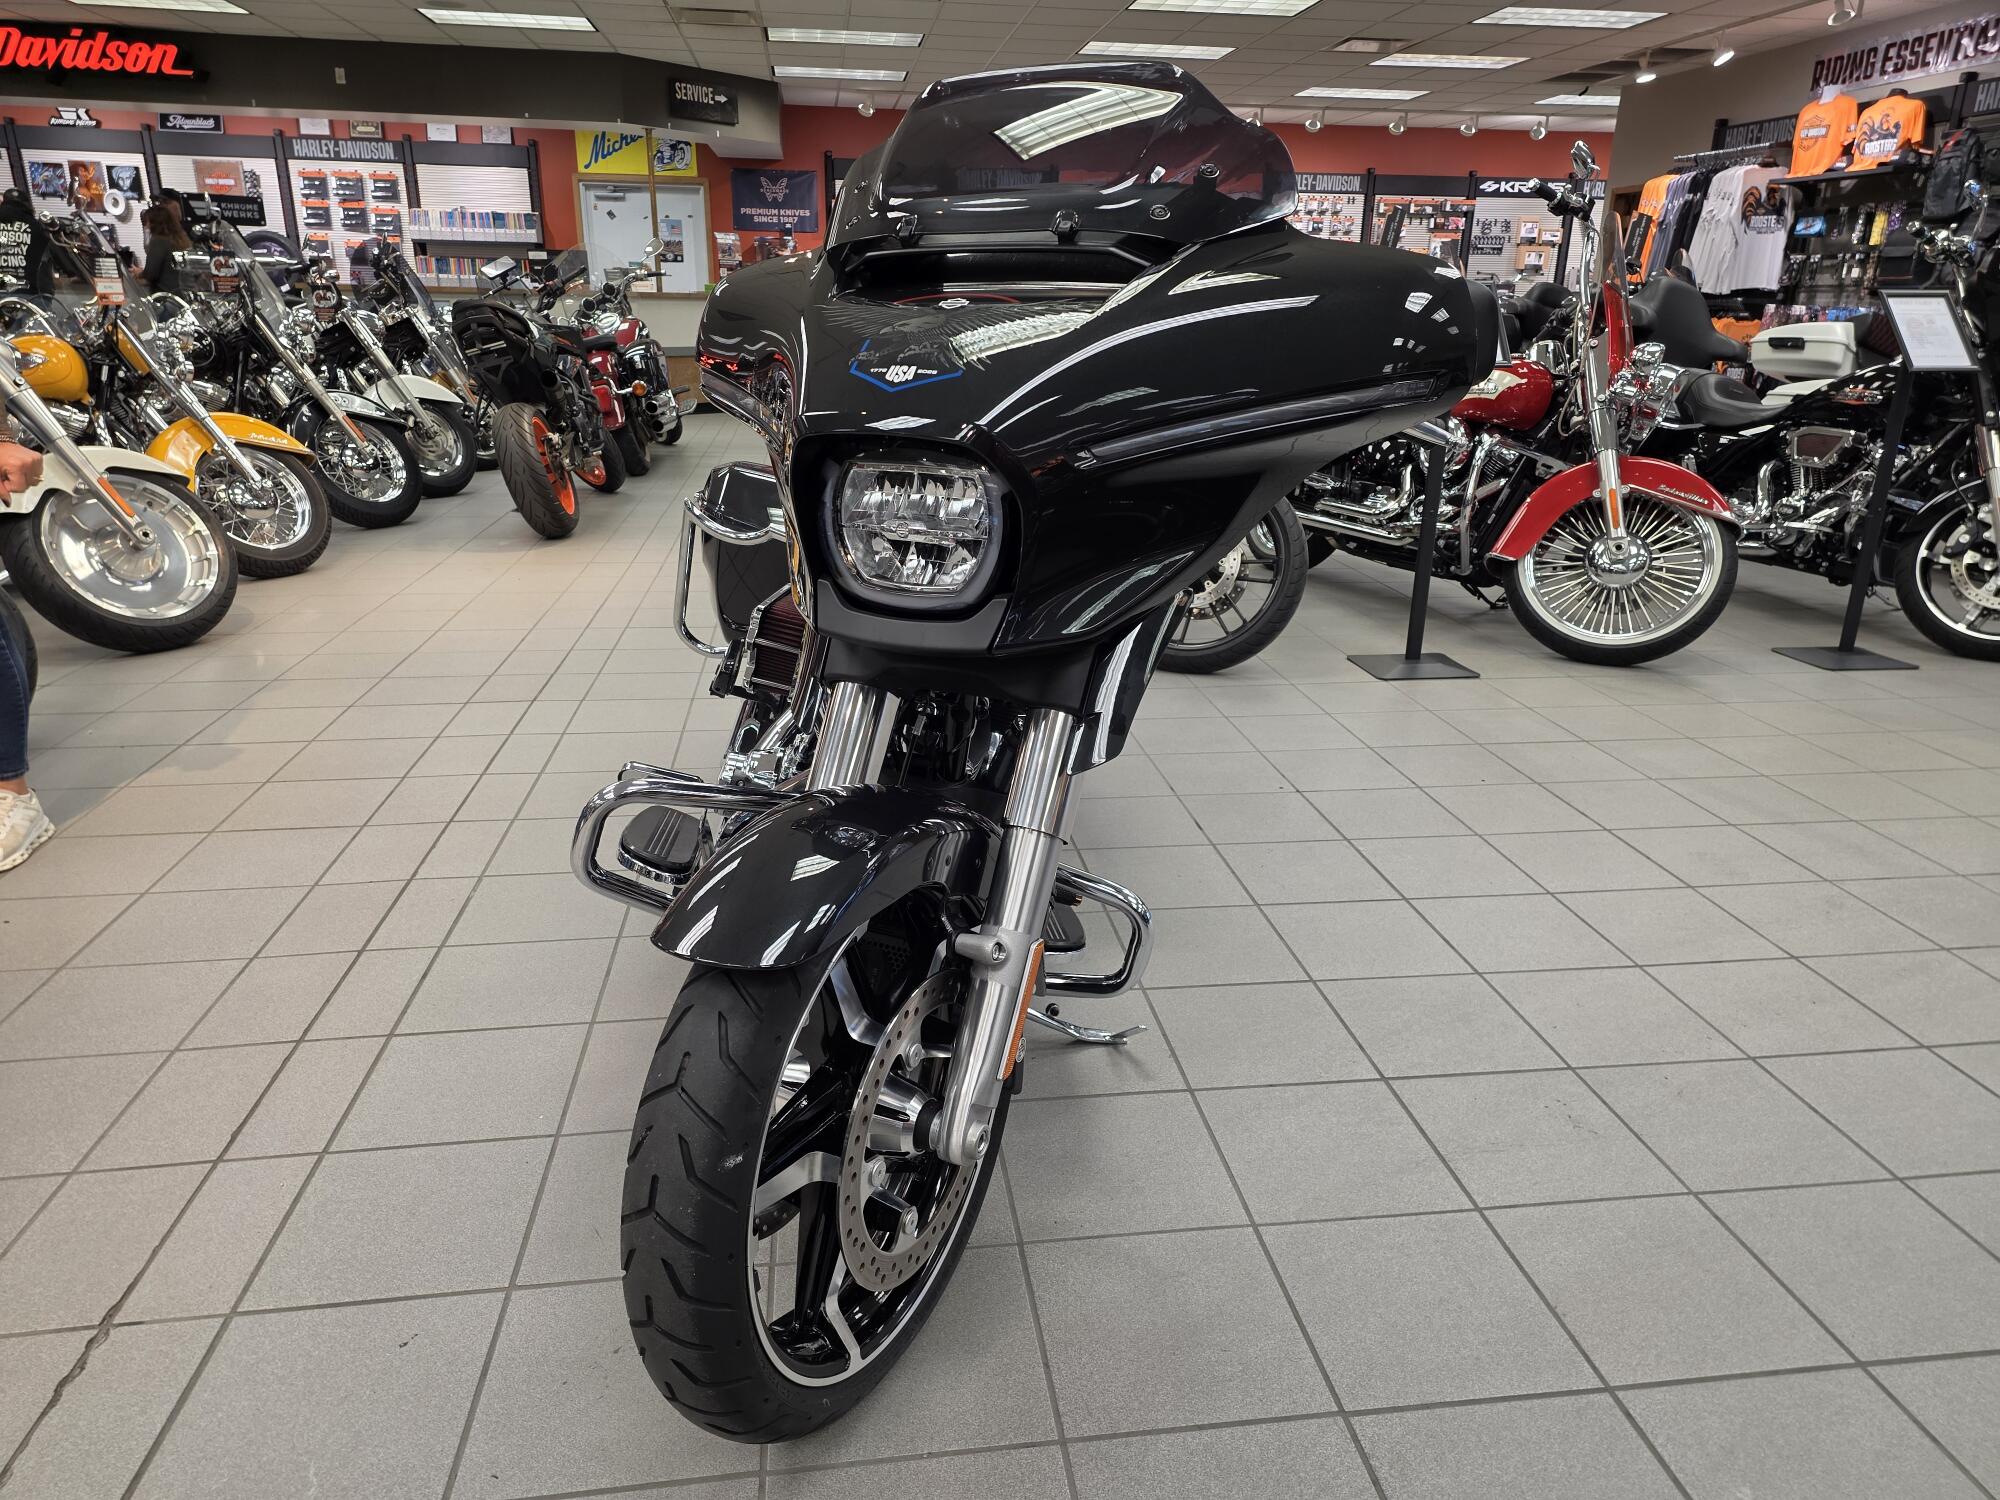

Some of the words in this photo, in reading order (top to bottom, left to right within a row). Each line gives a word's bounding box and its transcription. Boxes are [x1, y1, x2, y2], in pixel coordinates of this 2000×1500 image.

[0, 27, 194, 76] Davidson
[675, 82, 715, 104] SERVICE
[1724, 117, 1797, 150] HARLEY-DAVIDS
[292, 138, 395, 160] HARLEY-DAVIDSON
[1296, 174, 1361, 192] LEY-DAVIDSON
[220, 202, 259, 211] KHROME
[222, 210, 260, 219] WERKS
[740, 207, 779, 216] PREMIUM
[780, 209, 811, 217] KNIVES
[753, 215, 779, 223] SINCE
[884, 364, 918, 383] USA
